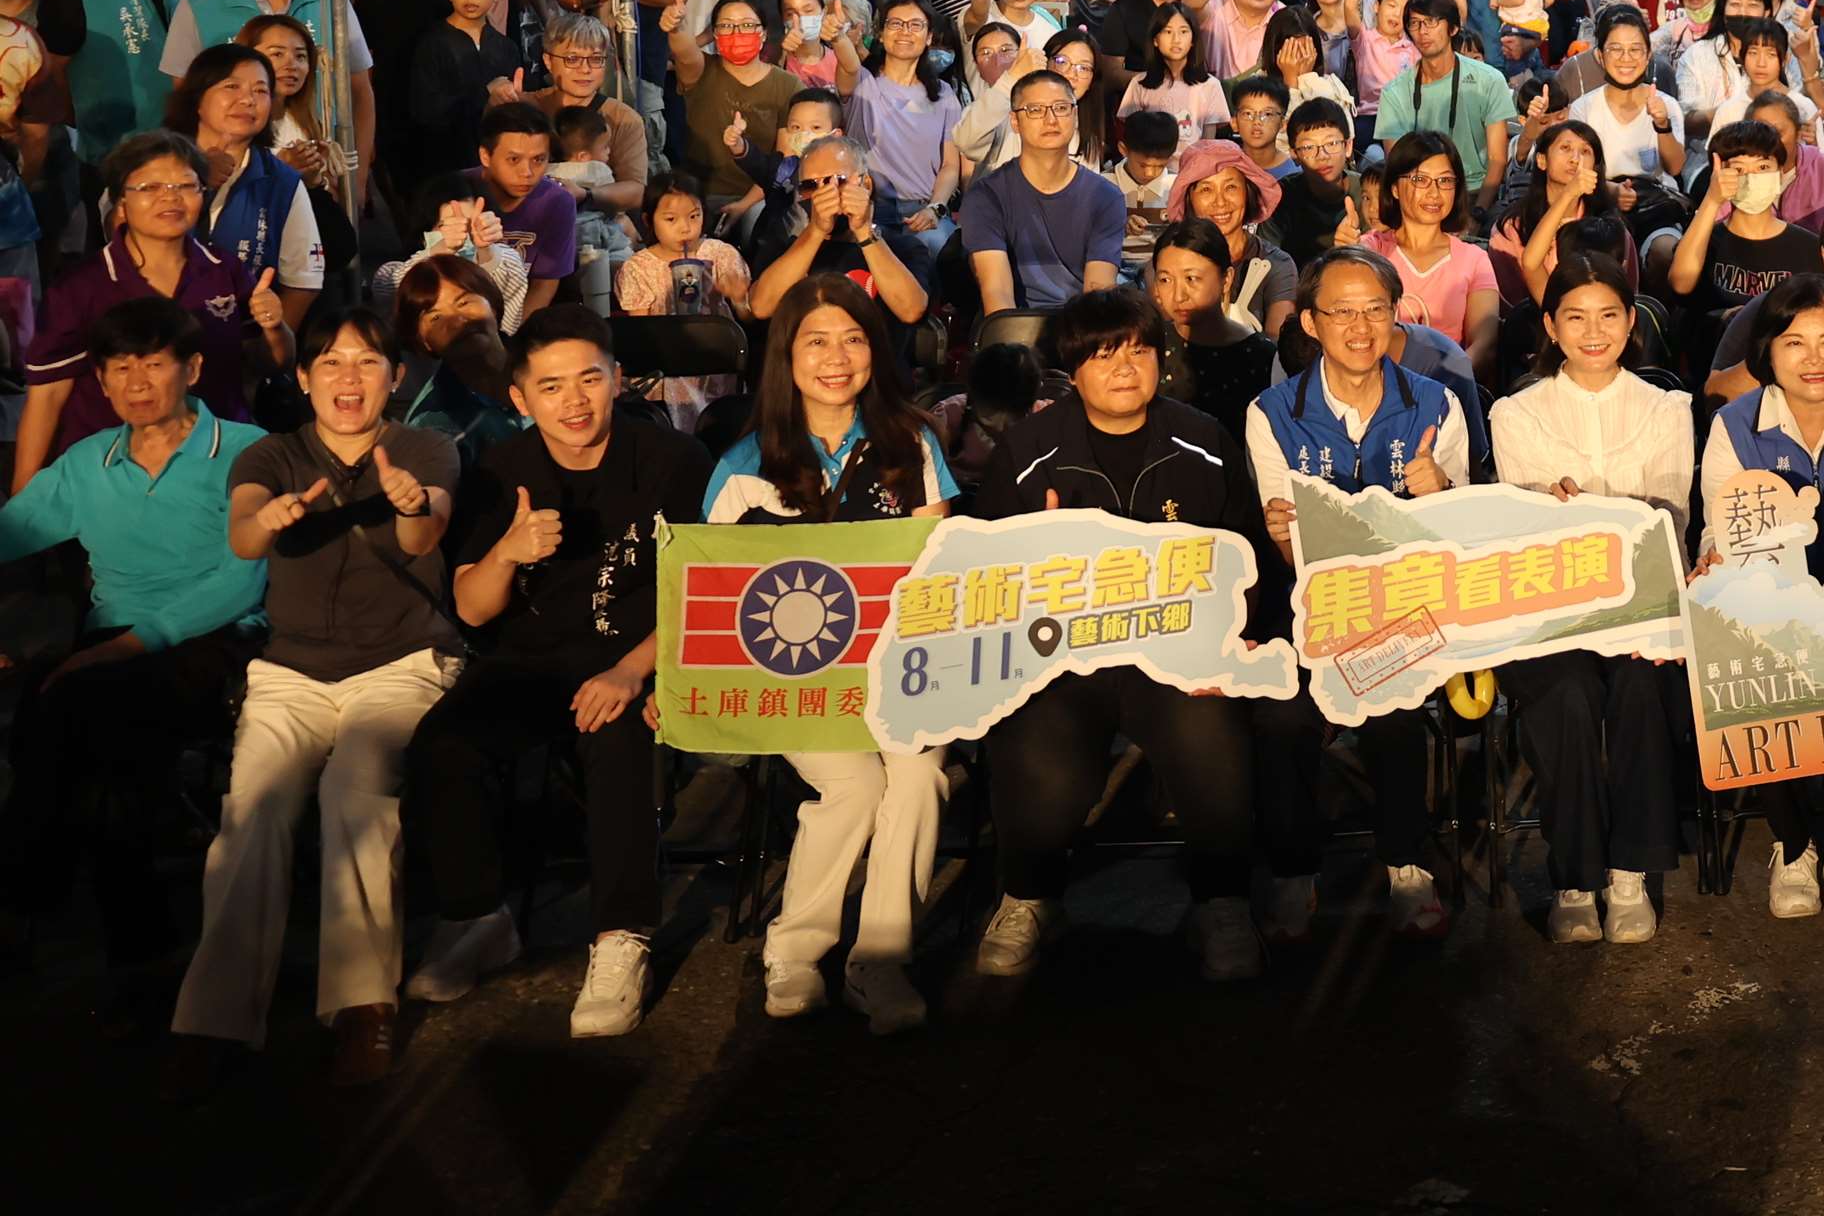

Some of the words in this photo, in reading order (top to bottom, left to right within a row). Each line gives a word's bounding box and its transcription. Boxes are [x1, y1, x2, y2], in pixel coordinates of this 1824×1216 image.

[1714, 262, 1793, 296] MARV
[896, 534, 1217, 640] 藝術宅急便
[1306, 534, 1614, 643] 集章看表演
[1067, 598, 1193, 650] 藝術下鄉
[1703, 668, 1818, 715] YUNLIN
[1713, 718, 1804, 782] ART
